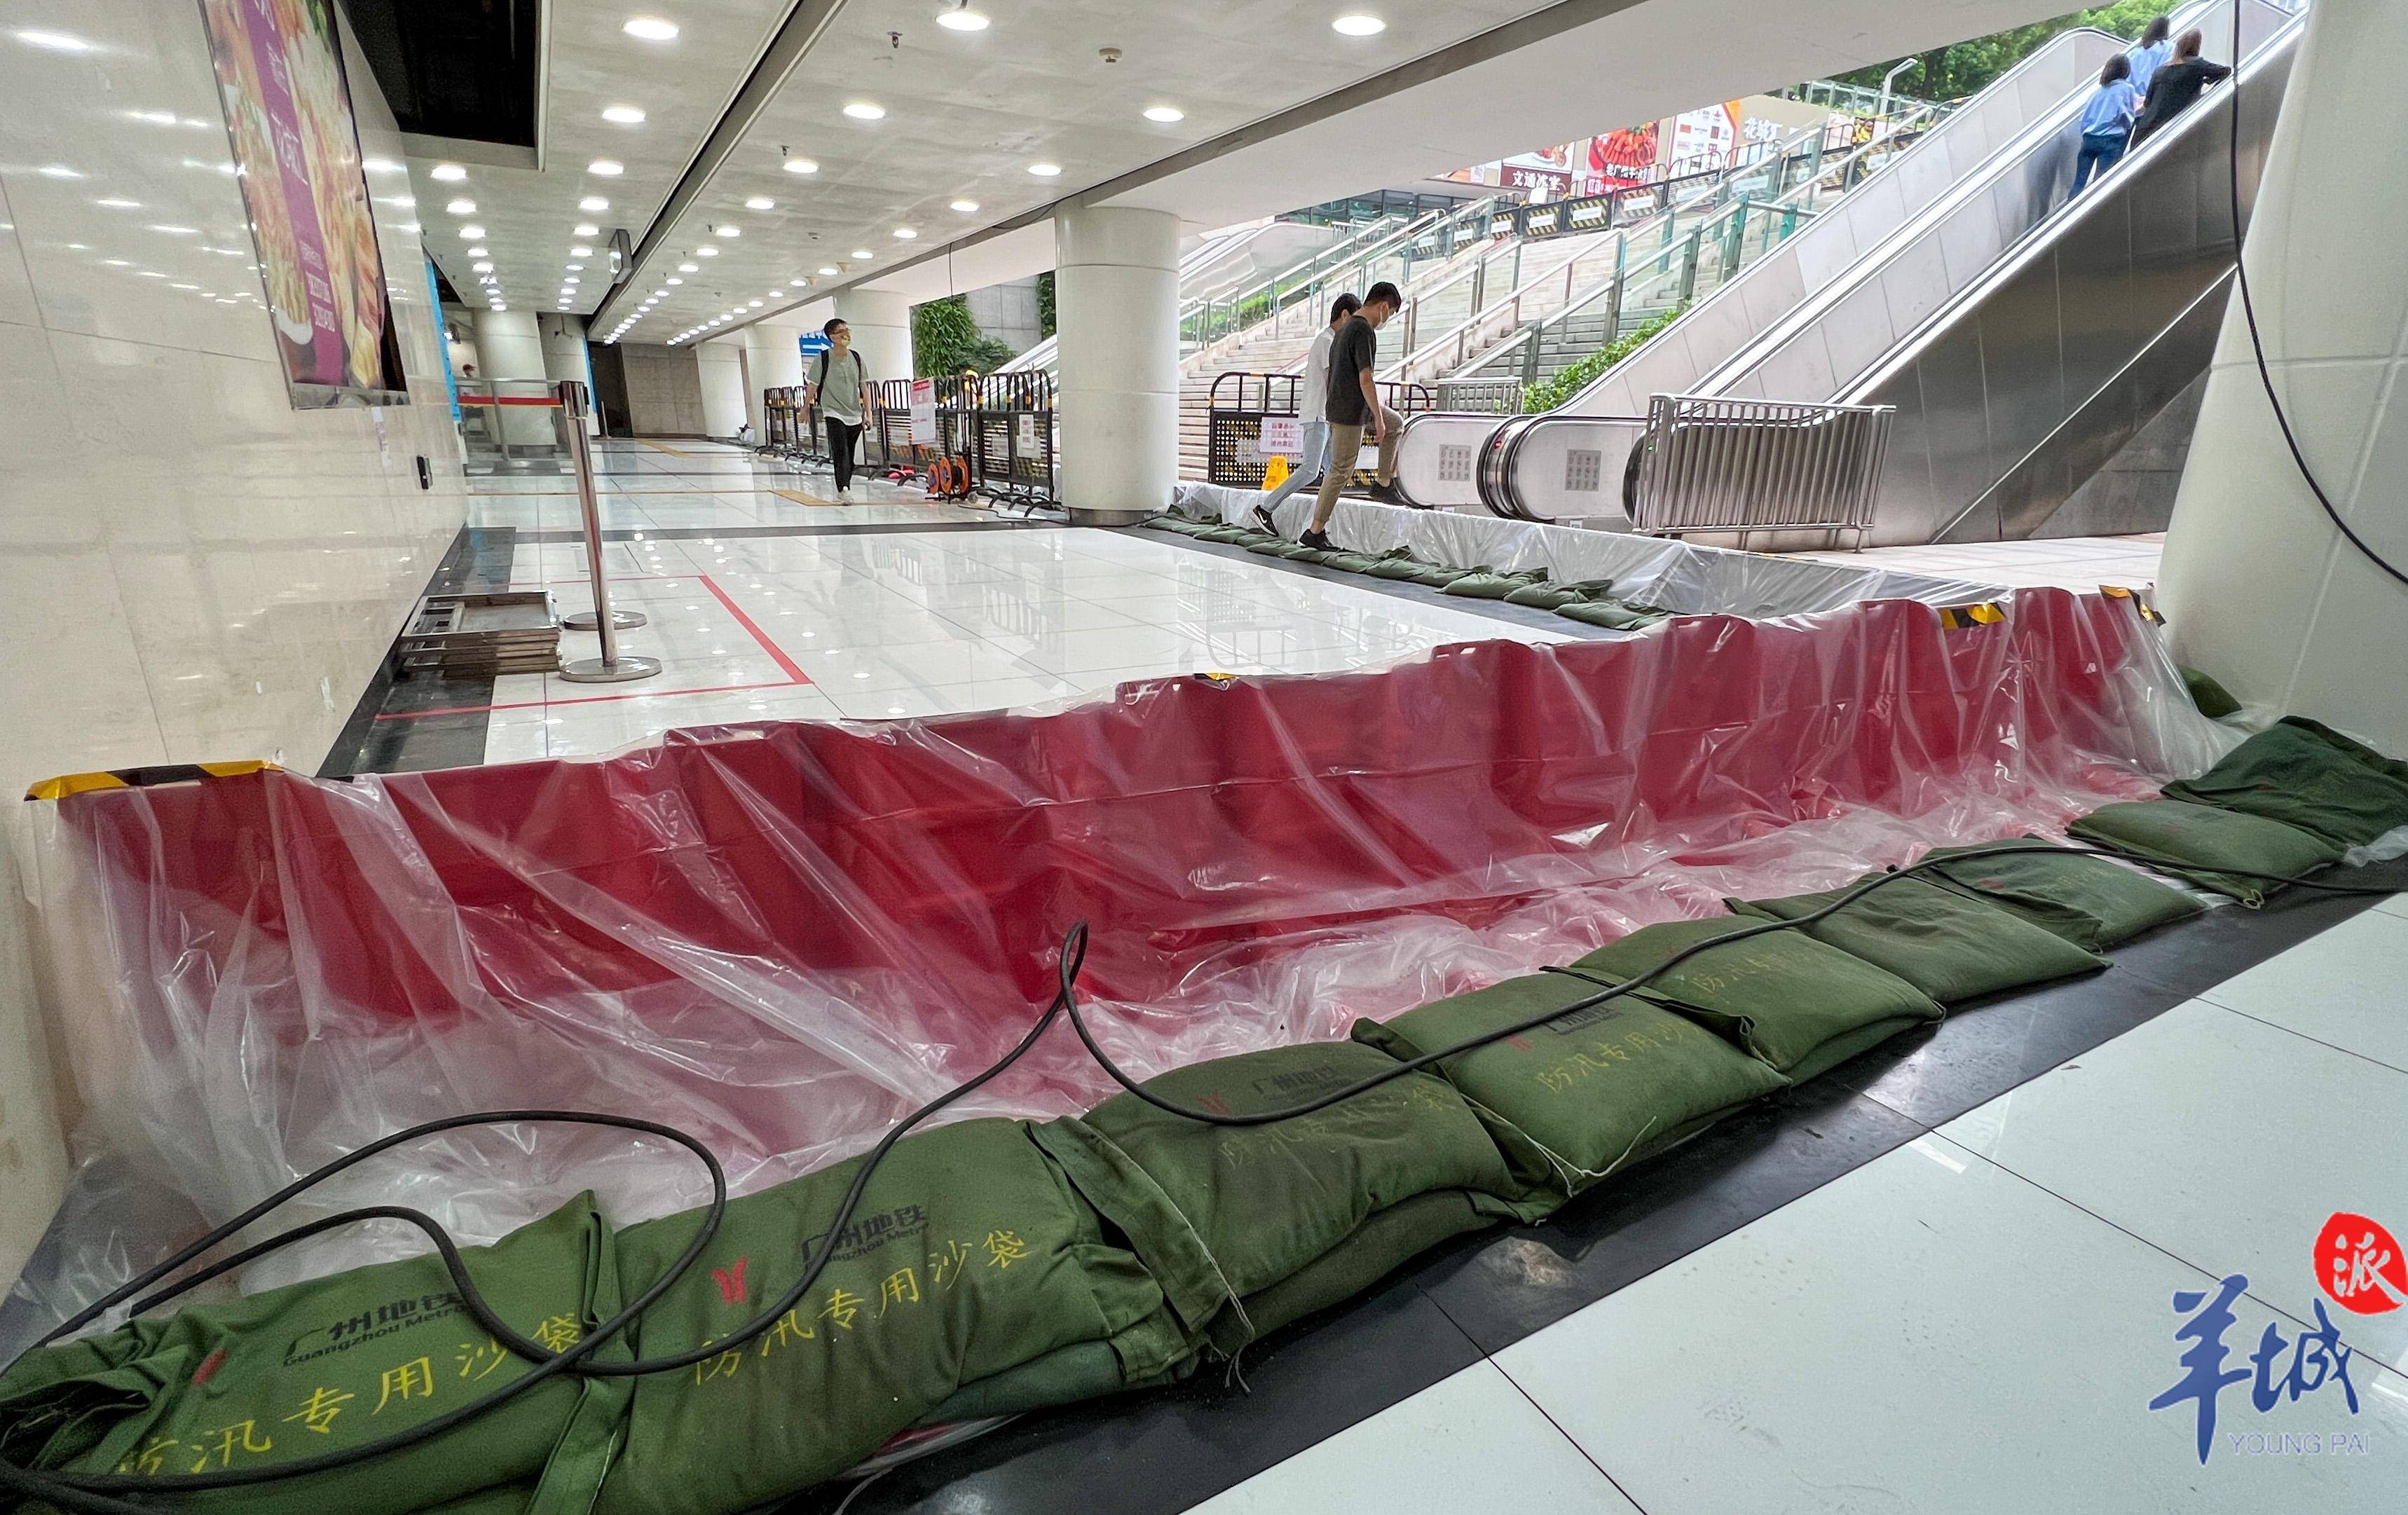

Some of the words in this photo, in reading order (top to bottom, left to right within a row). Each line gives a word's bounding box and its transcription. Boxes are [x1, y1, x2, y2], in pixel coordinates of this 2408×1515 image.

[1512, 170, 1561, 191] 文通冰室
[1537, 1017, 1703, 1095] 防汛专用沙
[285, 1291, 464, 1355] 广州地铁
[697, 1230, 1032, 1385] 防汛专用沙袋
[283, 1323, 399, 1367] Guangzhou
[118, 1312, 581, 1474] 防汛专用沙袋
